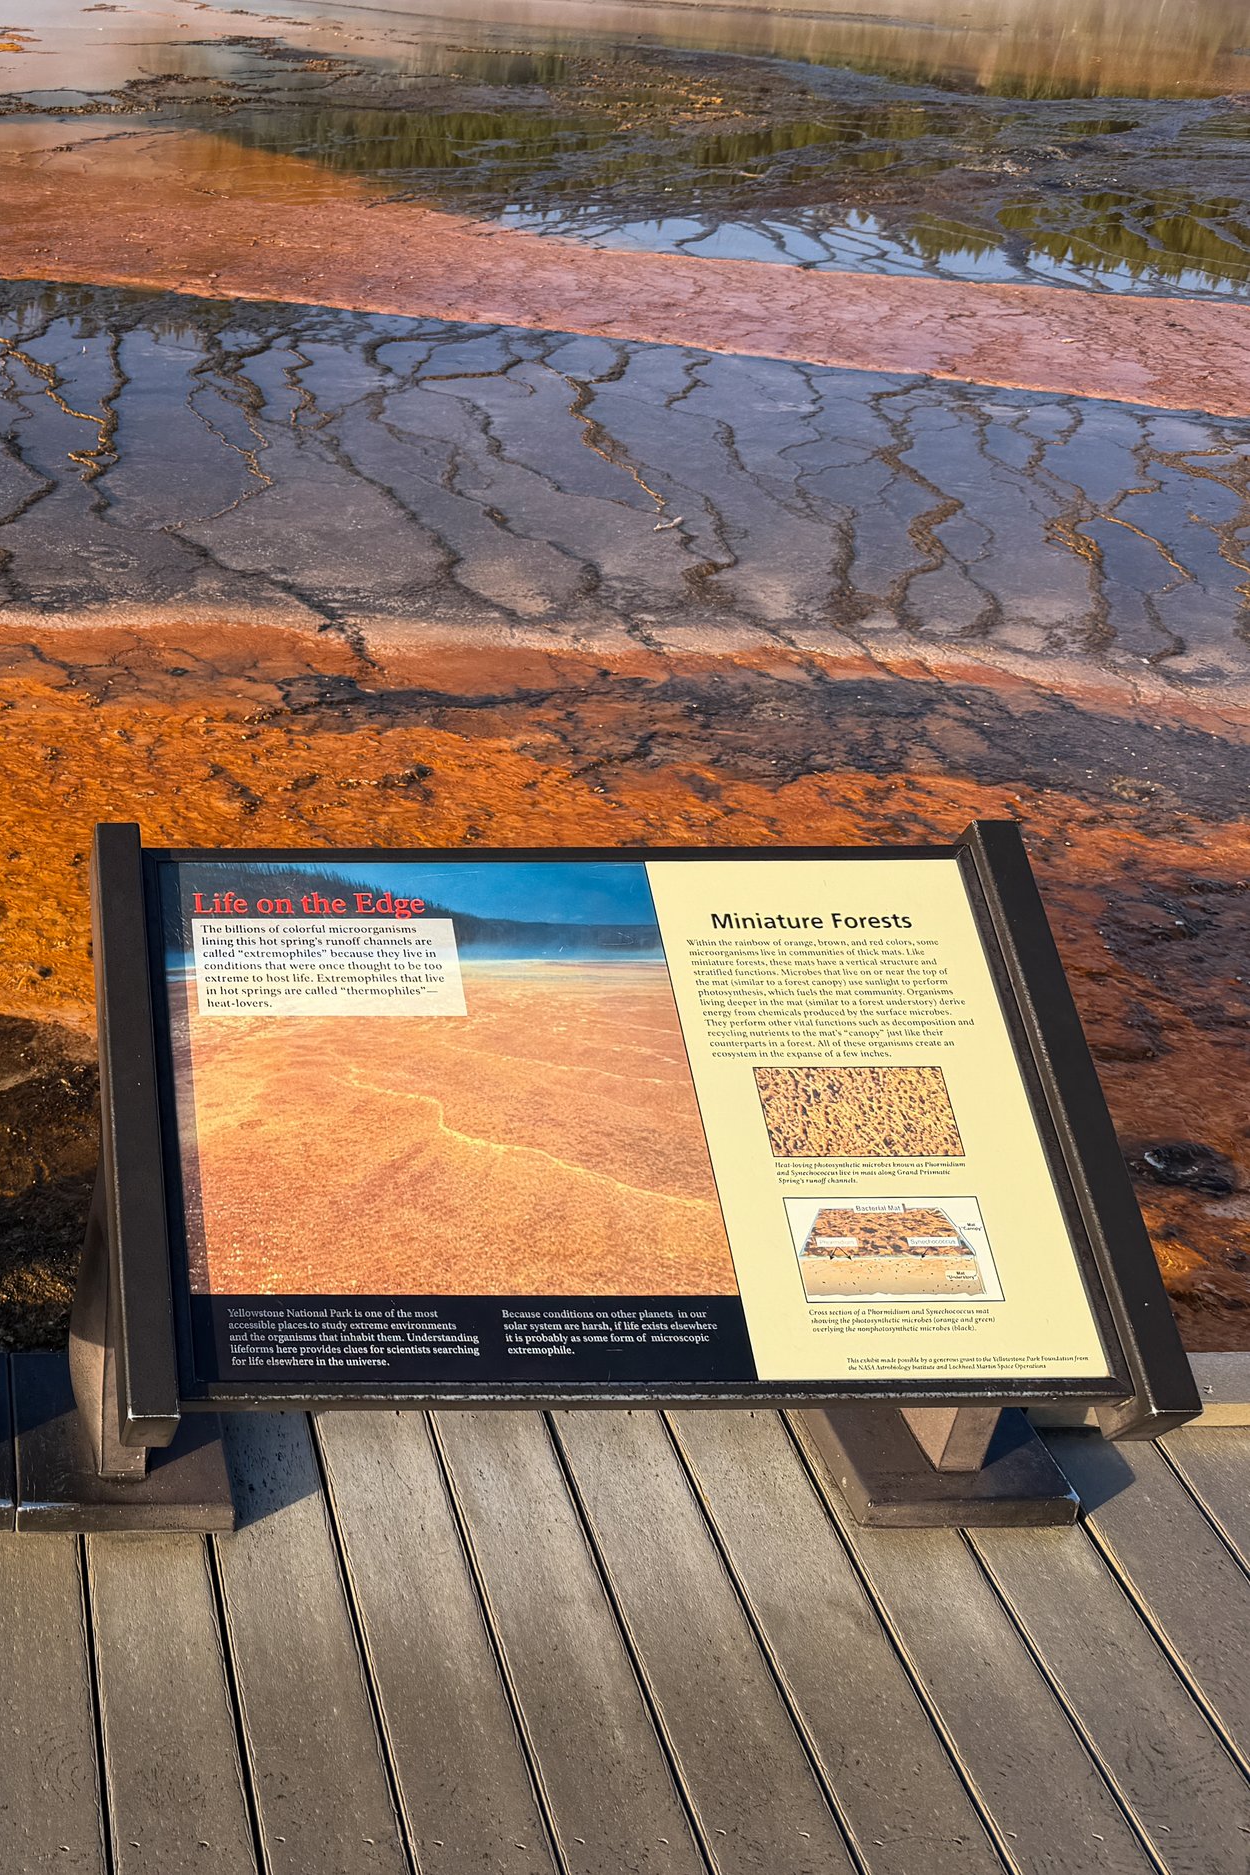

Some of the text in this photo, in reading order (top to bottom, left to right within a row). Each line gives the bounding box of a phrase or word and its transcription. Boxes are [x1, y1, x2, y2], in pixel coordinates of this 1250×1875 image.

[192, 892, 426, 919] Life on the Edge
[710, 912, 912, 929] Miniature Forests
[200, 924, 417, 936] The billions of colorful microorganisms
[201, 936, 234, 947] lining
[236, 936, 257, 946] this
[259, 936, 278, 946] hot
[325, 936, 361, 946] runoff
[363, 936, 413, 946] channels
[686, 939, 717, 947] Within
[734, 939, 771, 947] rainbow
[772, 938, 782, 946] of
[783, 940, 817, 948] orange,
[817, 939, 850, 947] brown,
[851, 938, 868, 946] and
[869, 938, 884, 946] red
[885, 938, 915, 946] colors,
[207, 998, 272, 1008] heat-lovers.
[805, 1177, 827, 1185] runoff
[910, 1238, 957, 1246] Synechococcus
[227, 1308, 285, 1318] Yellowstone
[286, 1308, 328, 1318] National
[329, 1308, 353, 1318] Park
[354, 1308, 363, 1318] is
[384, 1308, 395, 1318] of
[396, 1308, 413, 1318] the
[414, 1310, 439, 1318] most
[501, 1309, 707, 1320] Because conditions on other planets in our
[853, 1308, 861, 1317] of
[925, 1308, 975, 1317] Synechococcus
